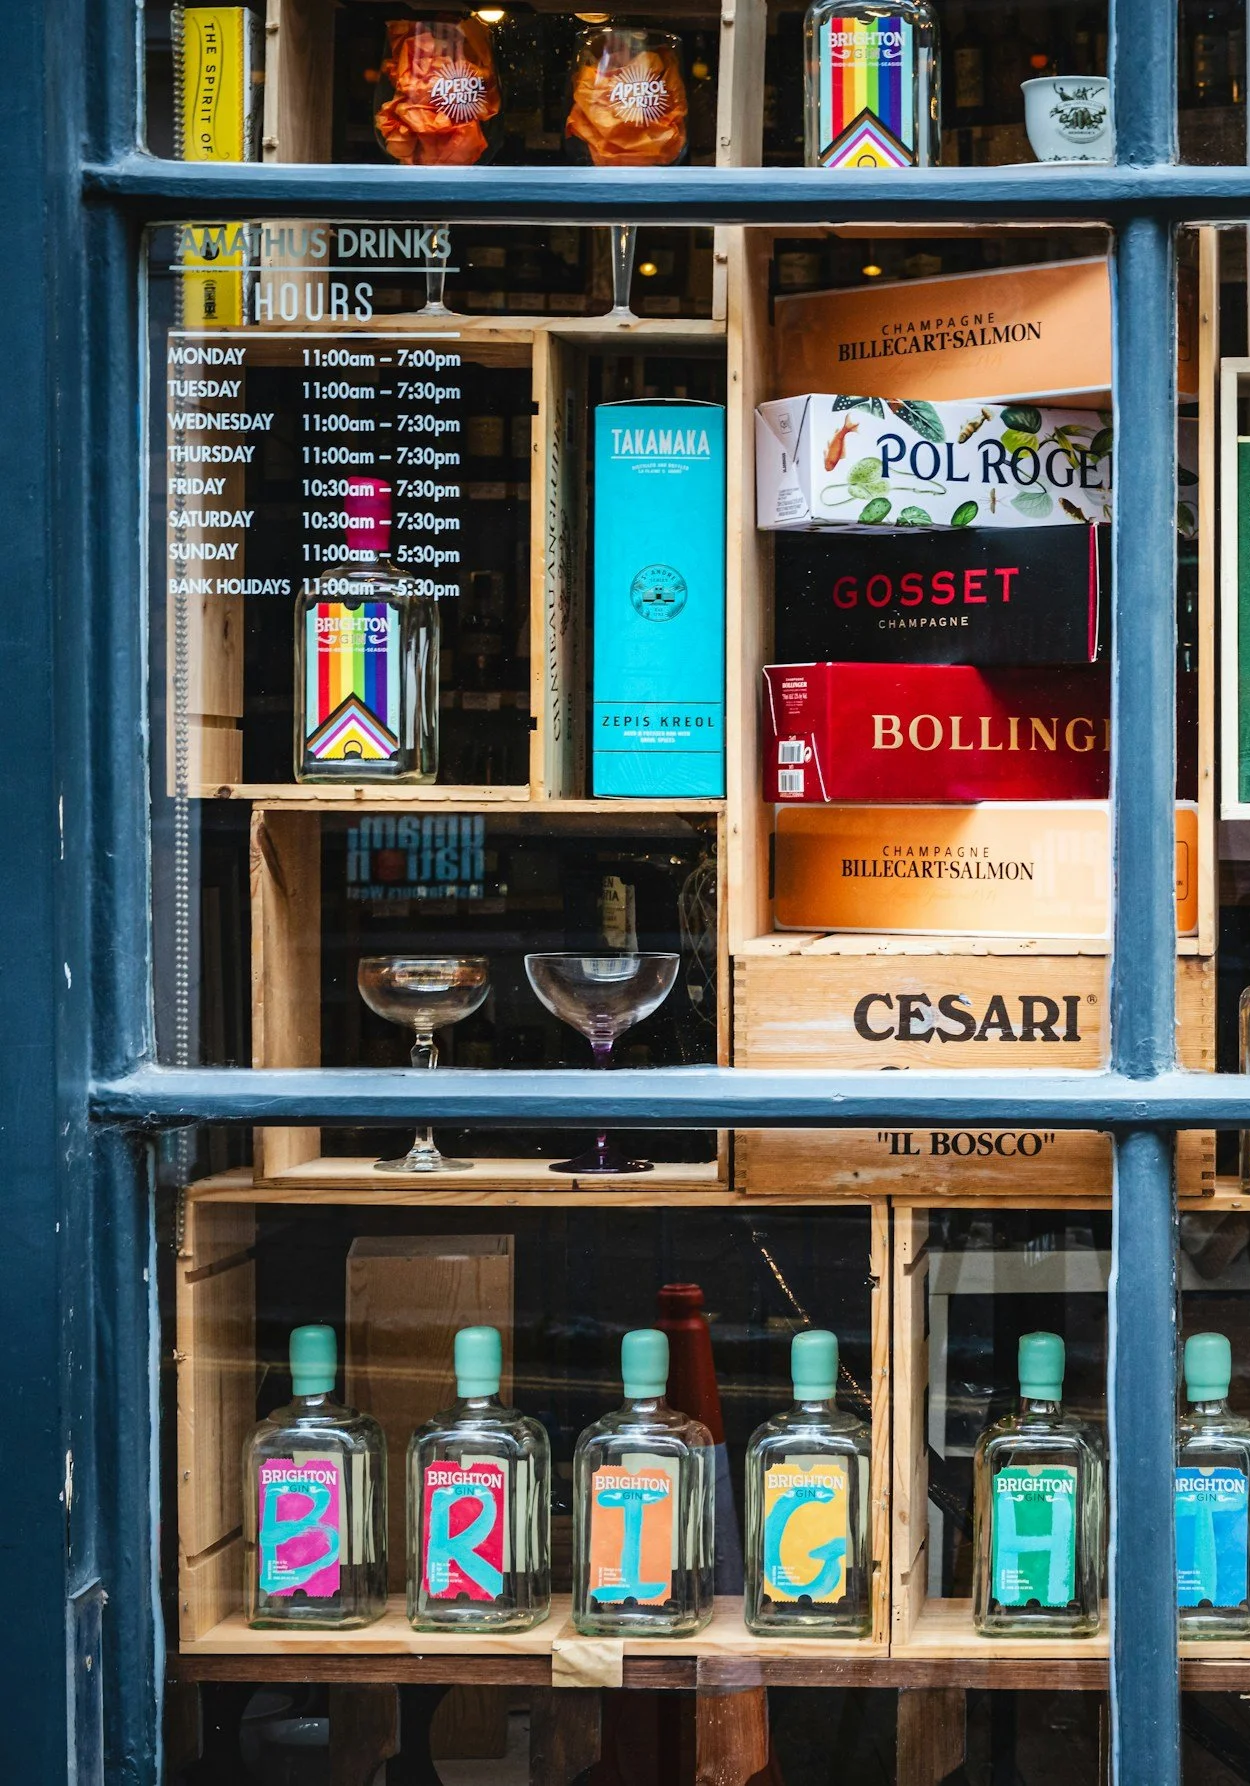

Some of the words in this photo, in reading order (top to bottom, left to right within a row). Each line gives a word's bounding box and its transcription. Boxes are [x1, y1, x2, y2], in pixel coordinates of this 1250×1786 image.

[204, 23, 217, 55] THE
[827, 30, 906, 48] BRIGHTON
[201, 64, 217, 123] SPIRIT
[431, 77, 486, 98] APEROL
[441, 90, 479, 105] SPRITZ
[609, 80, 667, 102] APEROL
[621, 93, 661, 110] SPRITZ
[200, 133, 214, 154] OF
[176, 226, 328, 259] AMATHUS
[337, 228, 452, 259] DRINKS
[254, 282, 374, 322] HOURS
[882, 312, 996, 336] CHAMPAGNE
[838, 321, 1042, 363] BILLECART-SALMON
[167, 347, 246, 366] MONDAY
[302, 349, 375, 367] 11:00am
[397, 349, 461, 372] 7:00pm
[167, 380, 242, 398] TUESDAY
[302, 381, 375, 400] 11:00am
[397, 381, 461, 404] 7:30pm
[168, 413, 274, 431] WEDNESDAY
[302, 414, 375, 432] 11:00am
[397, 414, 461, 437] 7:30pm
[611, 428, 710, 455] TAKAMAKA
[168, 446, 255, 463] THURSDAY
[302, 447, 375, 465] 11:00am
[396, 447, 461, 470] 7:30pm
[876, 433, 971, 482] POL
[977, 438, 1112, 491] ROGE
[168, 478, 226, 495] FRIDAY
[302, 479, 375, 498] 10:30am
[396, 479, 461, 502] 7:30pm
[168, 511, 254, 528] SATURDAY
[302, 512, 375, 530] 10:30am
[396, 512, 461, 535] 7:30pm
[168, 543, 239, 560] SUNDAY
[302, 544, 376, 563] 11:00am
[397, 545, 461, 568] 5:30pm
[169, 578, 212, 595] BANK
[217, 578, 291, 595] HOLIDAYS
[833, 567, 1020, 609] GOSSET
[314, 617, 392, 633] BRIGHTON
[878, 616, 970, 629] CHAMPAGNE
[602, 716, 650, 727] ZEPIS
[660, 716, 714, 727] KREOL
[882, 845, 991, 858] CHAMPAGNE
[841, 858, 1035, 882] BILLECART-SALMON
[853, 992, 1082, 1043] CESARI
[262, 1469, 337, 1486] BRIGHTON
[427, 1470, 503, 1489] BRIGHTON
[595, 1475, 671, 1494] BRIGHTON
[767, 1474, 845, 1490] BRIGHTON
[996, 1477, 1074, 1495] BRIGHTON
[1175, 1477, 1246, 1495] RIGHTON
[289, 1484, 310, 1494] GIN
[454, 1486, 475, 1496] GIN
[622, 1491, 643, 1500] GIN
[795, 1489, 817, 1498] GIN
[1024, 1492, 1045, 1502] GIN
[1196, 1492, 1217, 1502] GIN
